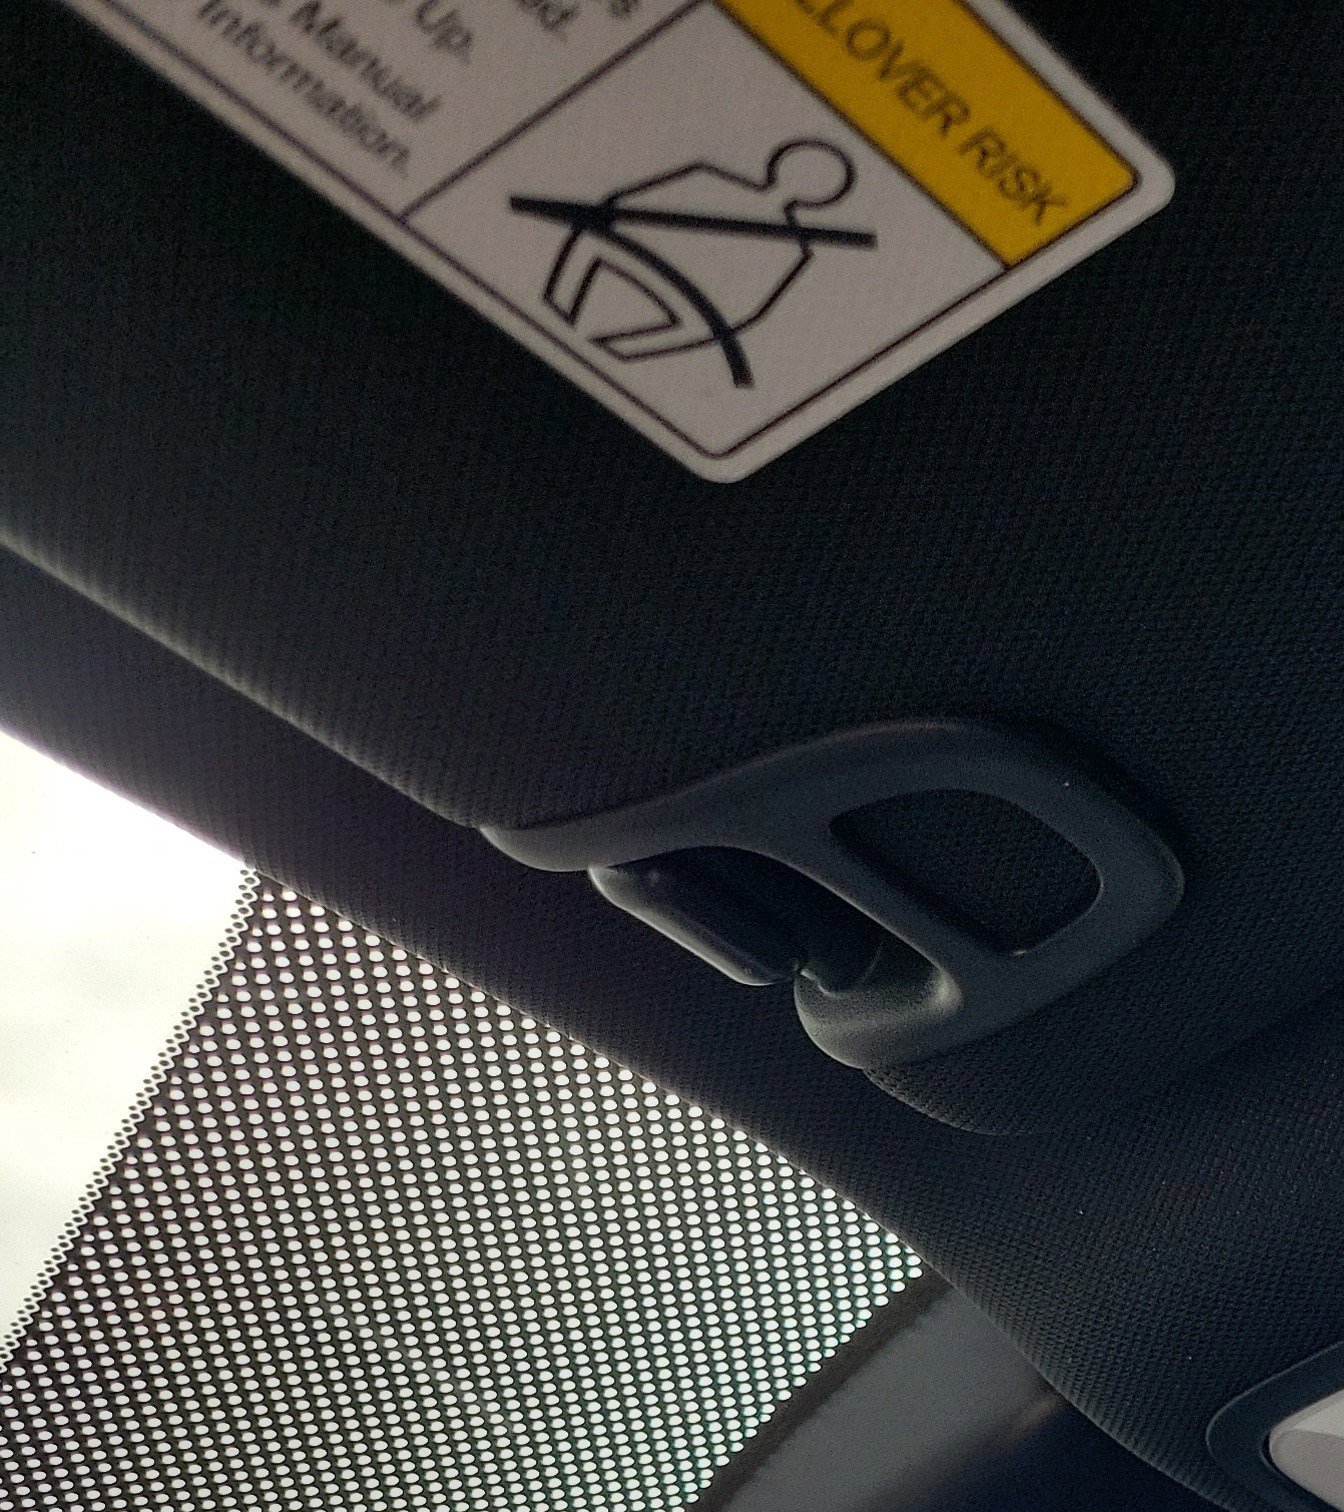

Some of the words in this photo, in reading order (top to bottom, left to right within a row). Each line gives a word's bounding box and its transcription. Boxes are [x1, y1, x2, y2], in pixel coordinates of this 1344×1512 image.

[290, 0, 443, 123] Manual
[792, 0, 972, 137] LOVER
[959, 127, 1068, 226] RISK
